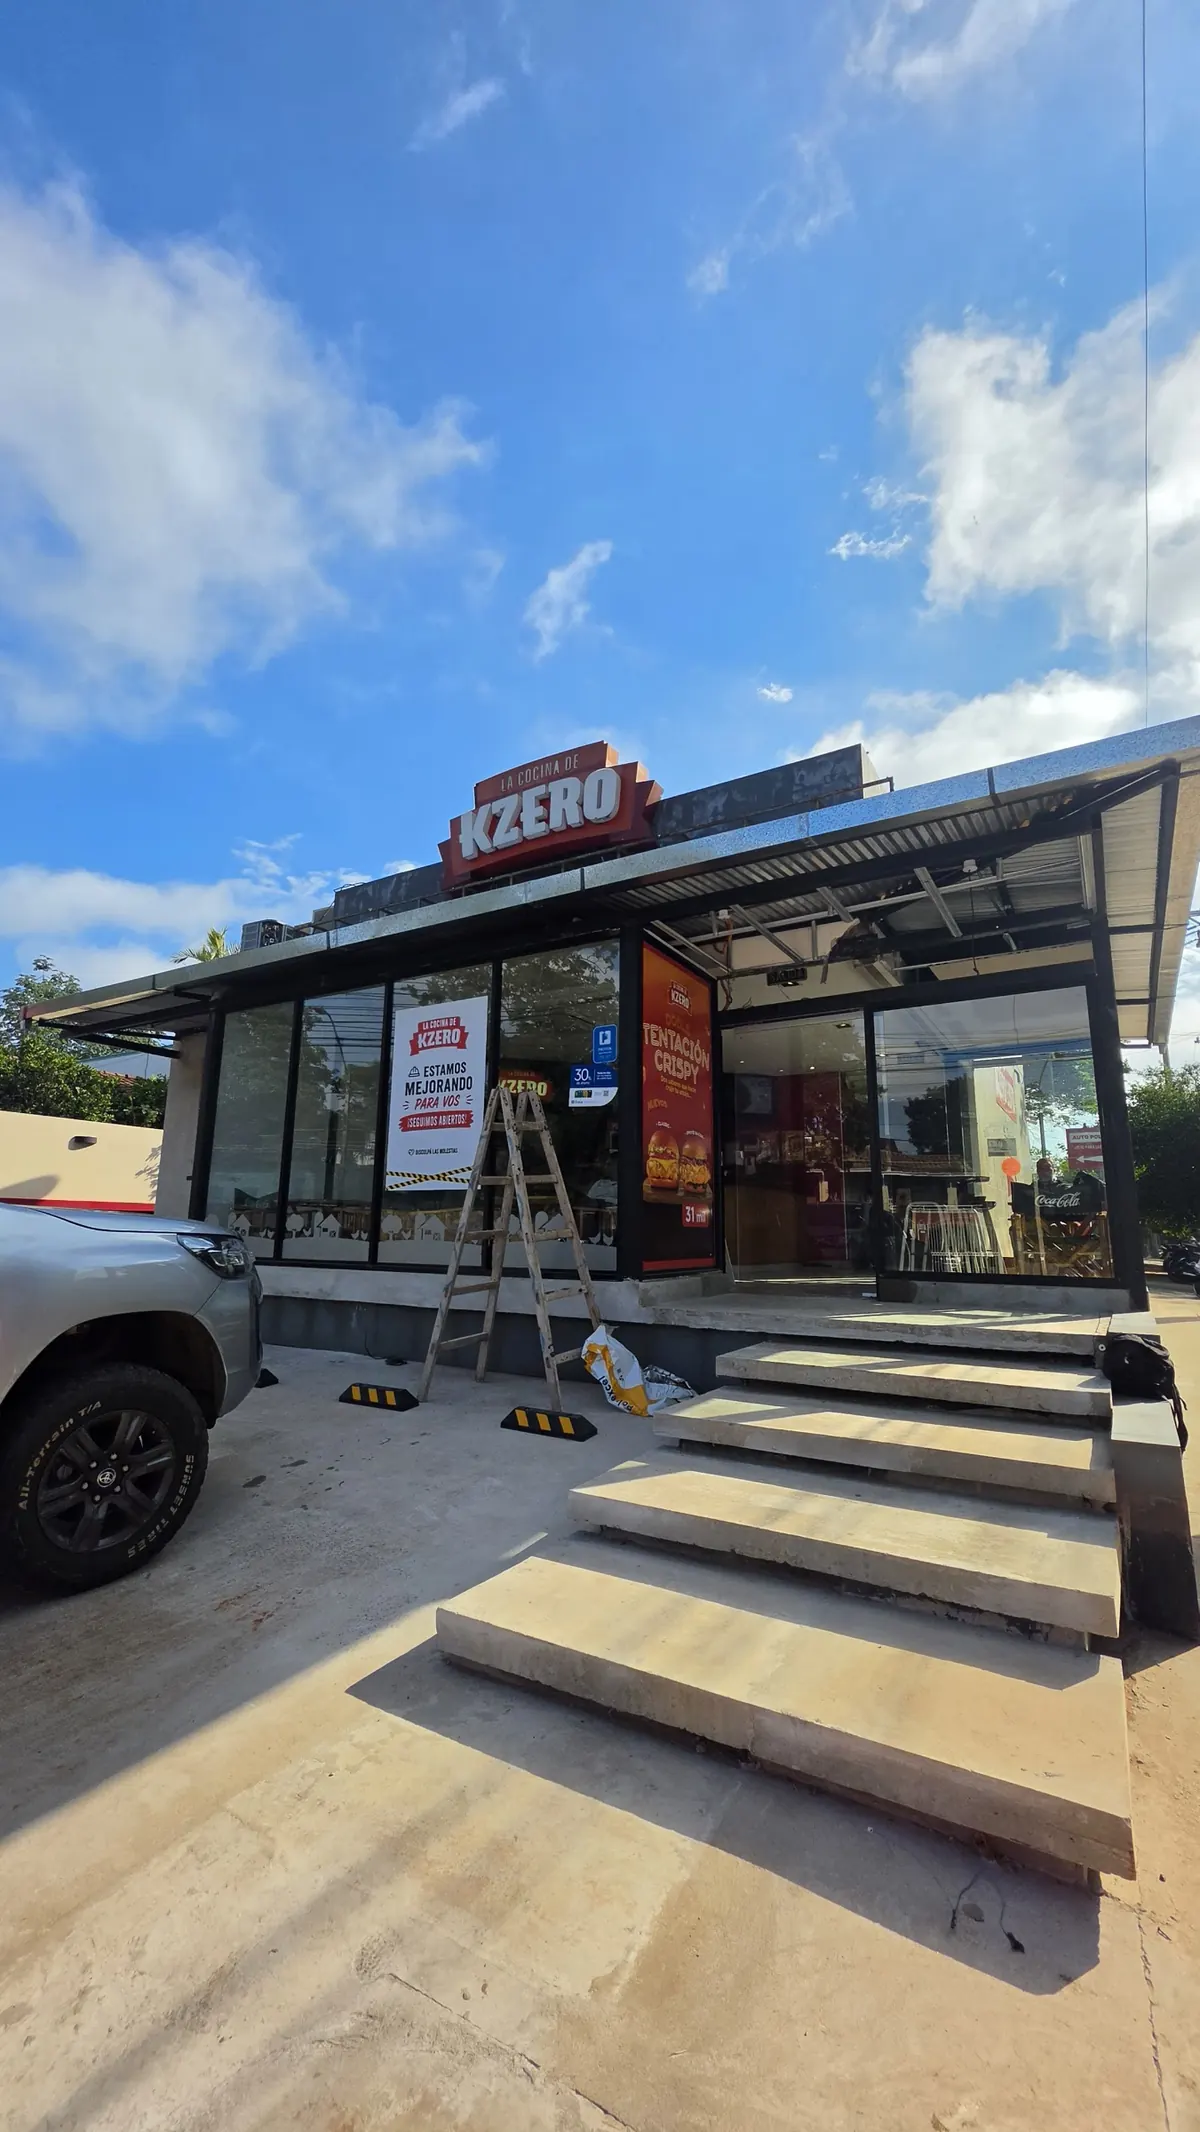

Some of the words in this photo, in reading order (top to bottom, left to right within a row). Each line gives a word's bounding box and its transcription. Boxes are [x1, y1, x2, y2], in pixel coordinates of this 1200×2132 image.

[501, 775, 513, 792] LA
[518, 763, 560, 786] COCINA
[565, 753, 579, 771] DE
[459, 767, 622, 861] KZERO
[422, 1021, 429, 1030] LA
[430, 1018, 449, 1029] COCINA
[449, 1017, 457, 1026] DE
[417, 1028, 461, 1049] KZERO
[642, 1022, 710, 1072] TENTACIÓN
[423, 1061, 467, 1078] ESTAMOS
[654, 1049, 699, 1085] CRISPY
[404, 1075, 473, 1097] MEJORANDO
[414, 1096, 440, 1110] PARA
[442, 1094, 461, 1108] VOS
[1035, 1192, 1081, 1208] Coca-Cola
[685, 1205, 695, 1223] 31
[78, 1400, 102, 1417] T/A
[170, 1454, 195, 1515] SUNSET
[127, 1517, 170, 1558] TIRES
